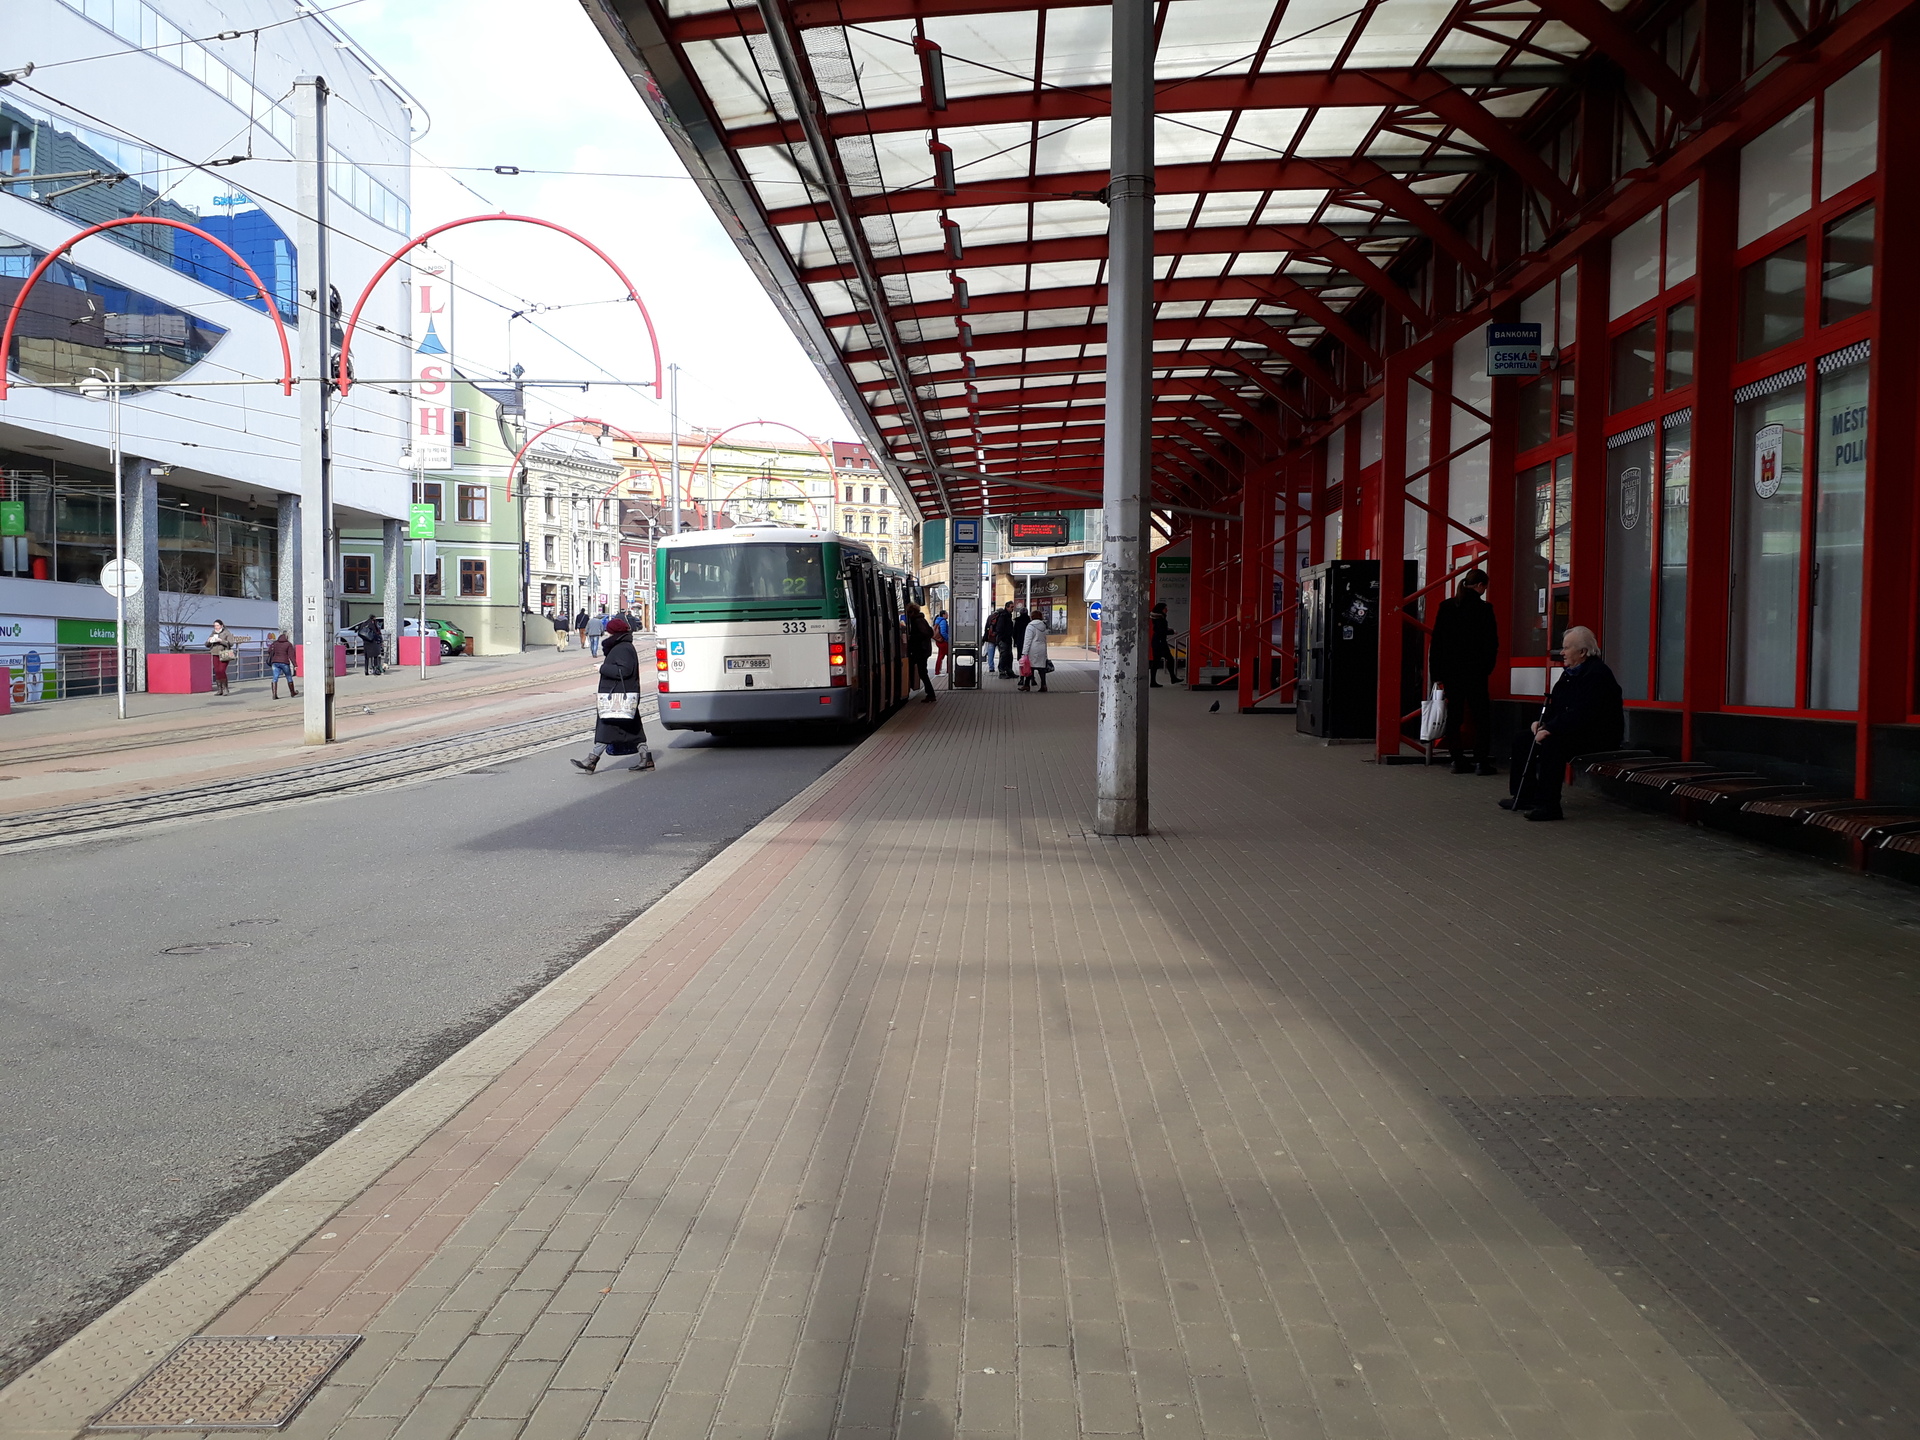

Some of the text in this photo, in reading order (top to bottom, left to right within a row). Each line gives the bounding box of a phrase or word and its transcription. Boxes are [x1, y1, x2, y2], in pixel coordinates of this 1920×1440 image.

[1494, 331, 1538, 339] BANKOMAT
[1494, 351, 1528, 362] ČESKÁ
[1494, 361, 1538, 370] SPOŘITELNA
[1832, 406, 1868, 436] MĚST
[1755, 427, 1782, 442] MĚSTSKÁ
[1756, 437, 1782, 451] POLICIE
[1621, 470, 1640, 481] MĚSTSKÁ
[1621, 479, 1640, 490] POLICIE
[1755, 476, 1780, 497] LIBEREC
[782, 578, 807, 594] 22
[782, 621, 807, 634] 333
[89, 628, 116, 639] Lékárna
[673, 660, 683, 668] 80
[733, 660, 745, 668] 2L7
